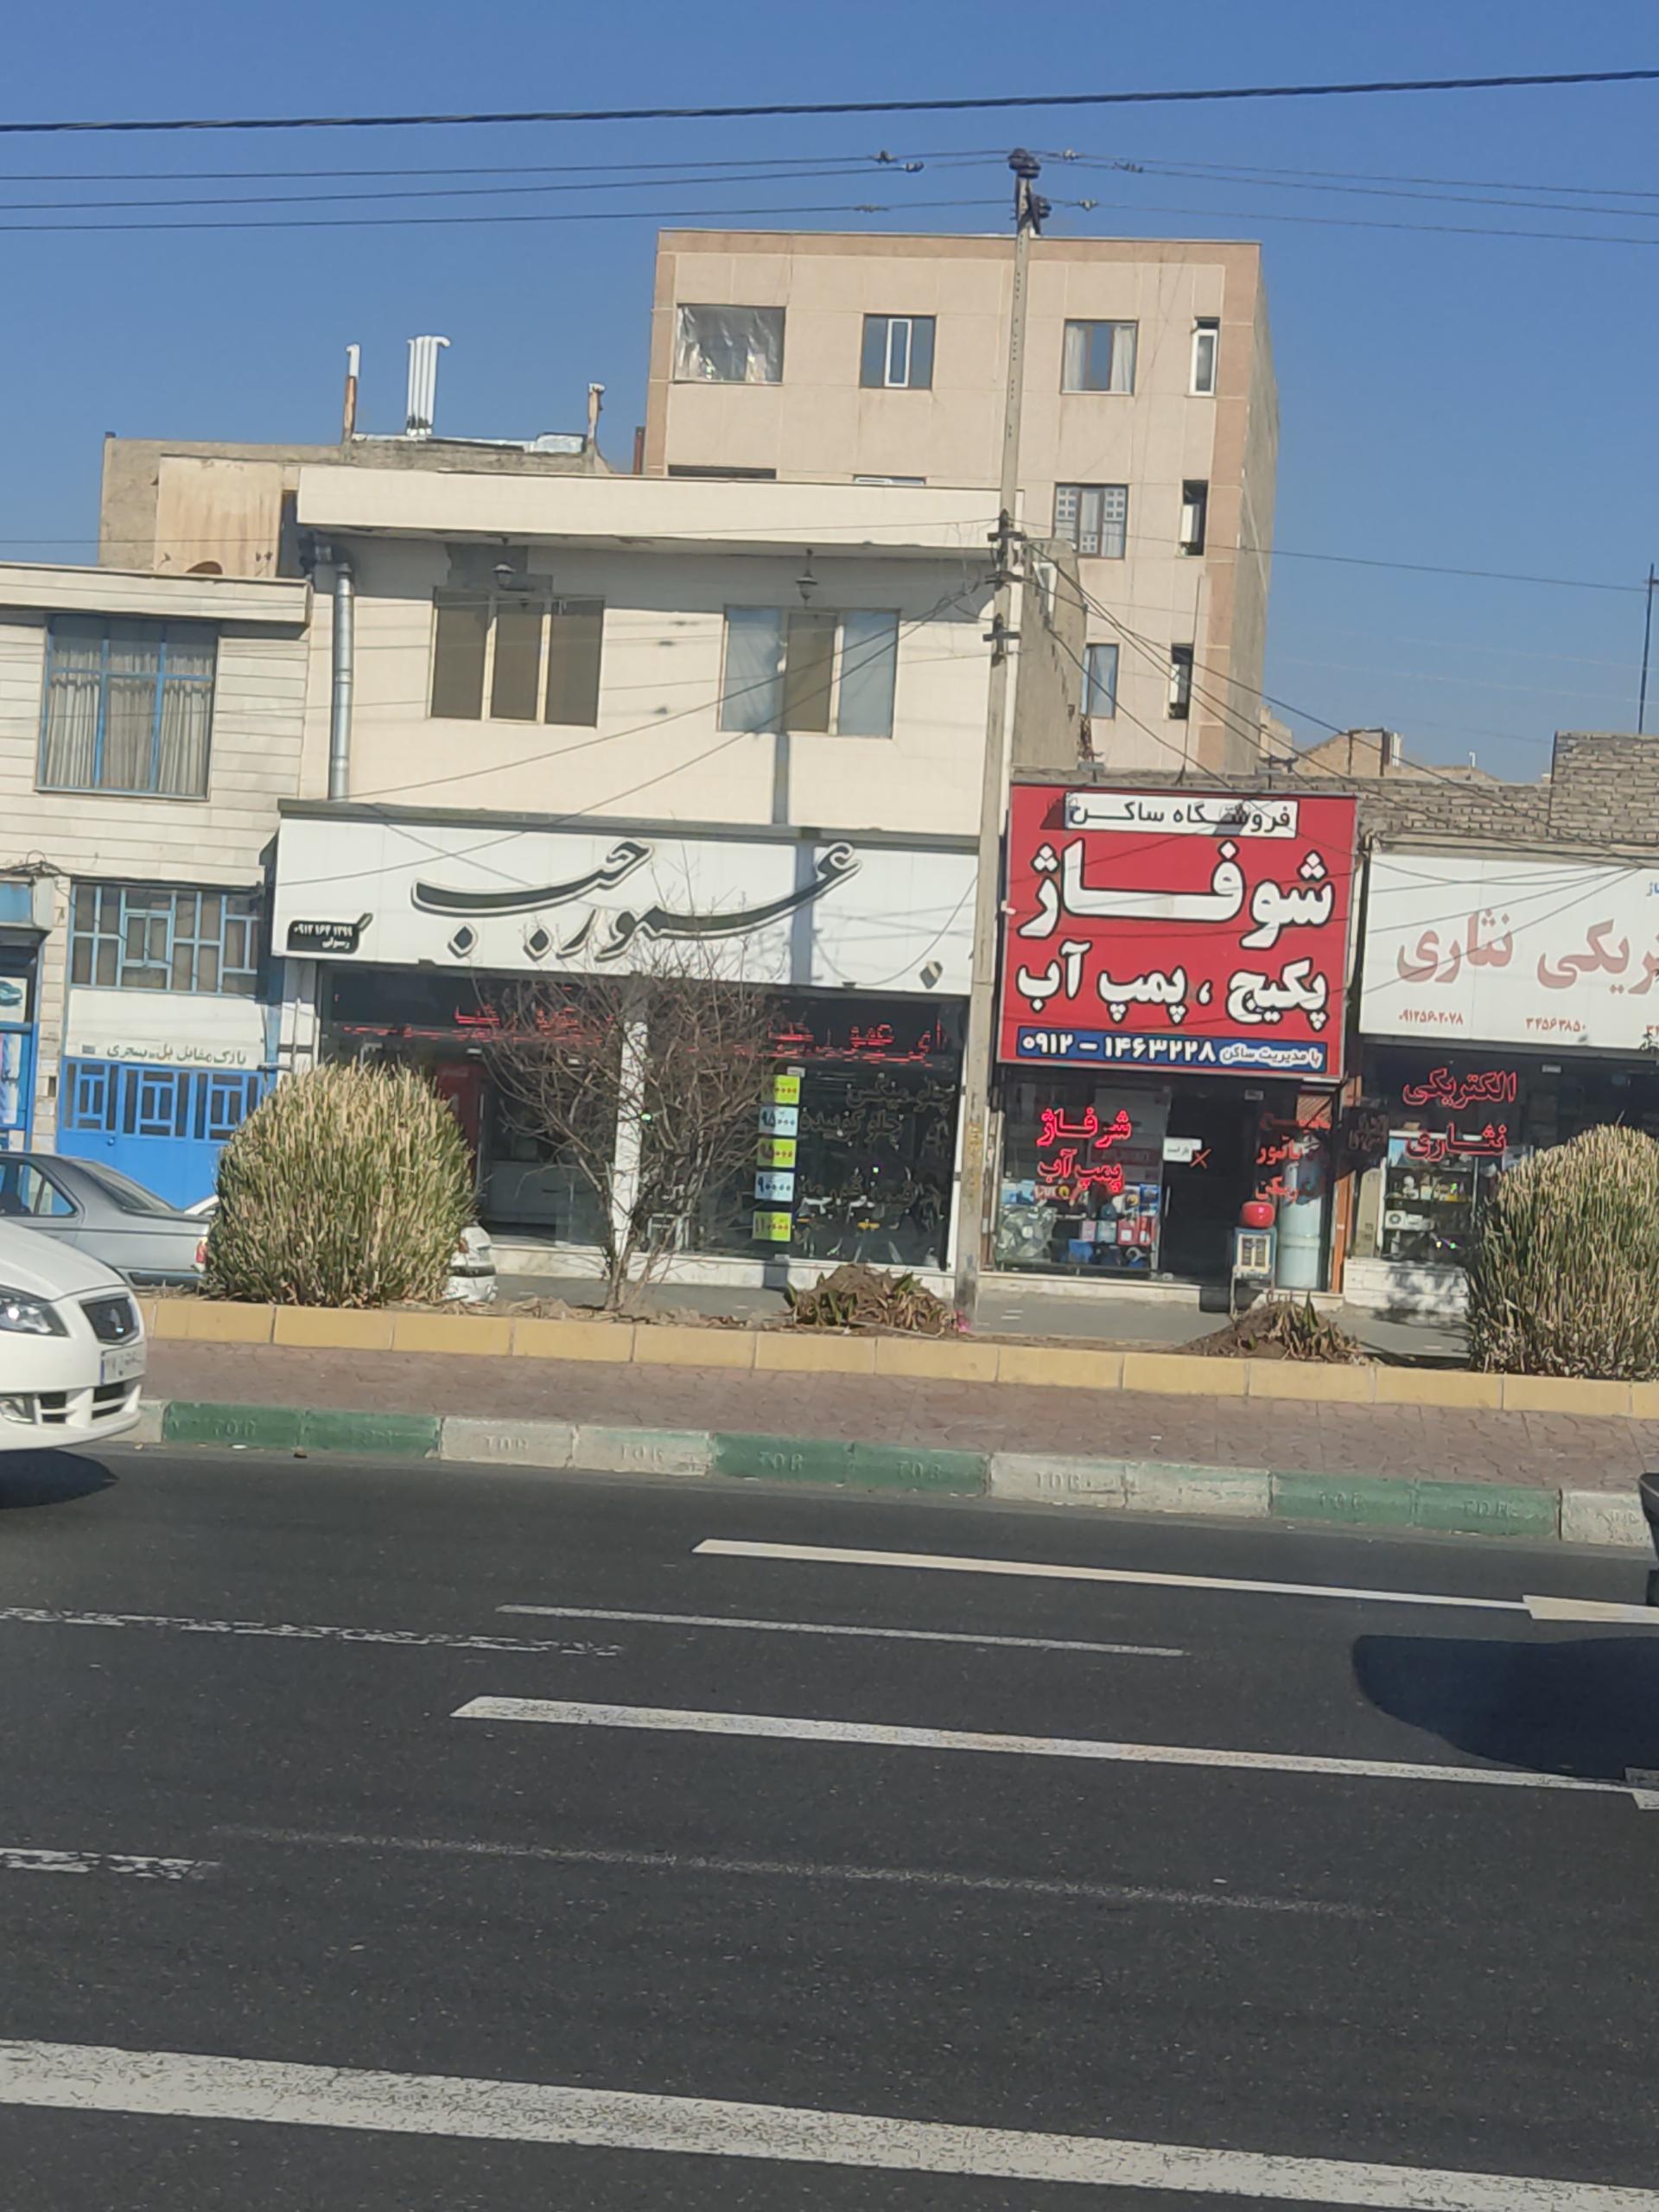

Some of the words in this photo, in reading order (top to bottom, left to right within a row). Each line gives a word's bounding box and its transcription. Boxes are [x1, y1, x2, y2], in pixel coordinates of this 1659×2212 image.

[1069, 800, 1165, 825] ساکن
[1173, 801, 1291, 833] فروشگاه
[1016, 837, 1335, 950] شوفاژ
[1396, 907, 1514, 983] نثاری
[1537, 918, 1659, 995] ریکی
[1016, 939, 1093, 1014] آب
[1097, 964, 1188, 1025] پمپ
[1226, 956, 1330, 1033] پکیج
[1219, 1045, 1257, 1063] ساکن
[1258, 1046, 1309, 1067] مدیریت
[1402, 1067, 1517, 1109] الکتریکی
[1037, 1148, 1078, 1184] آب
